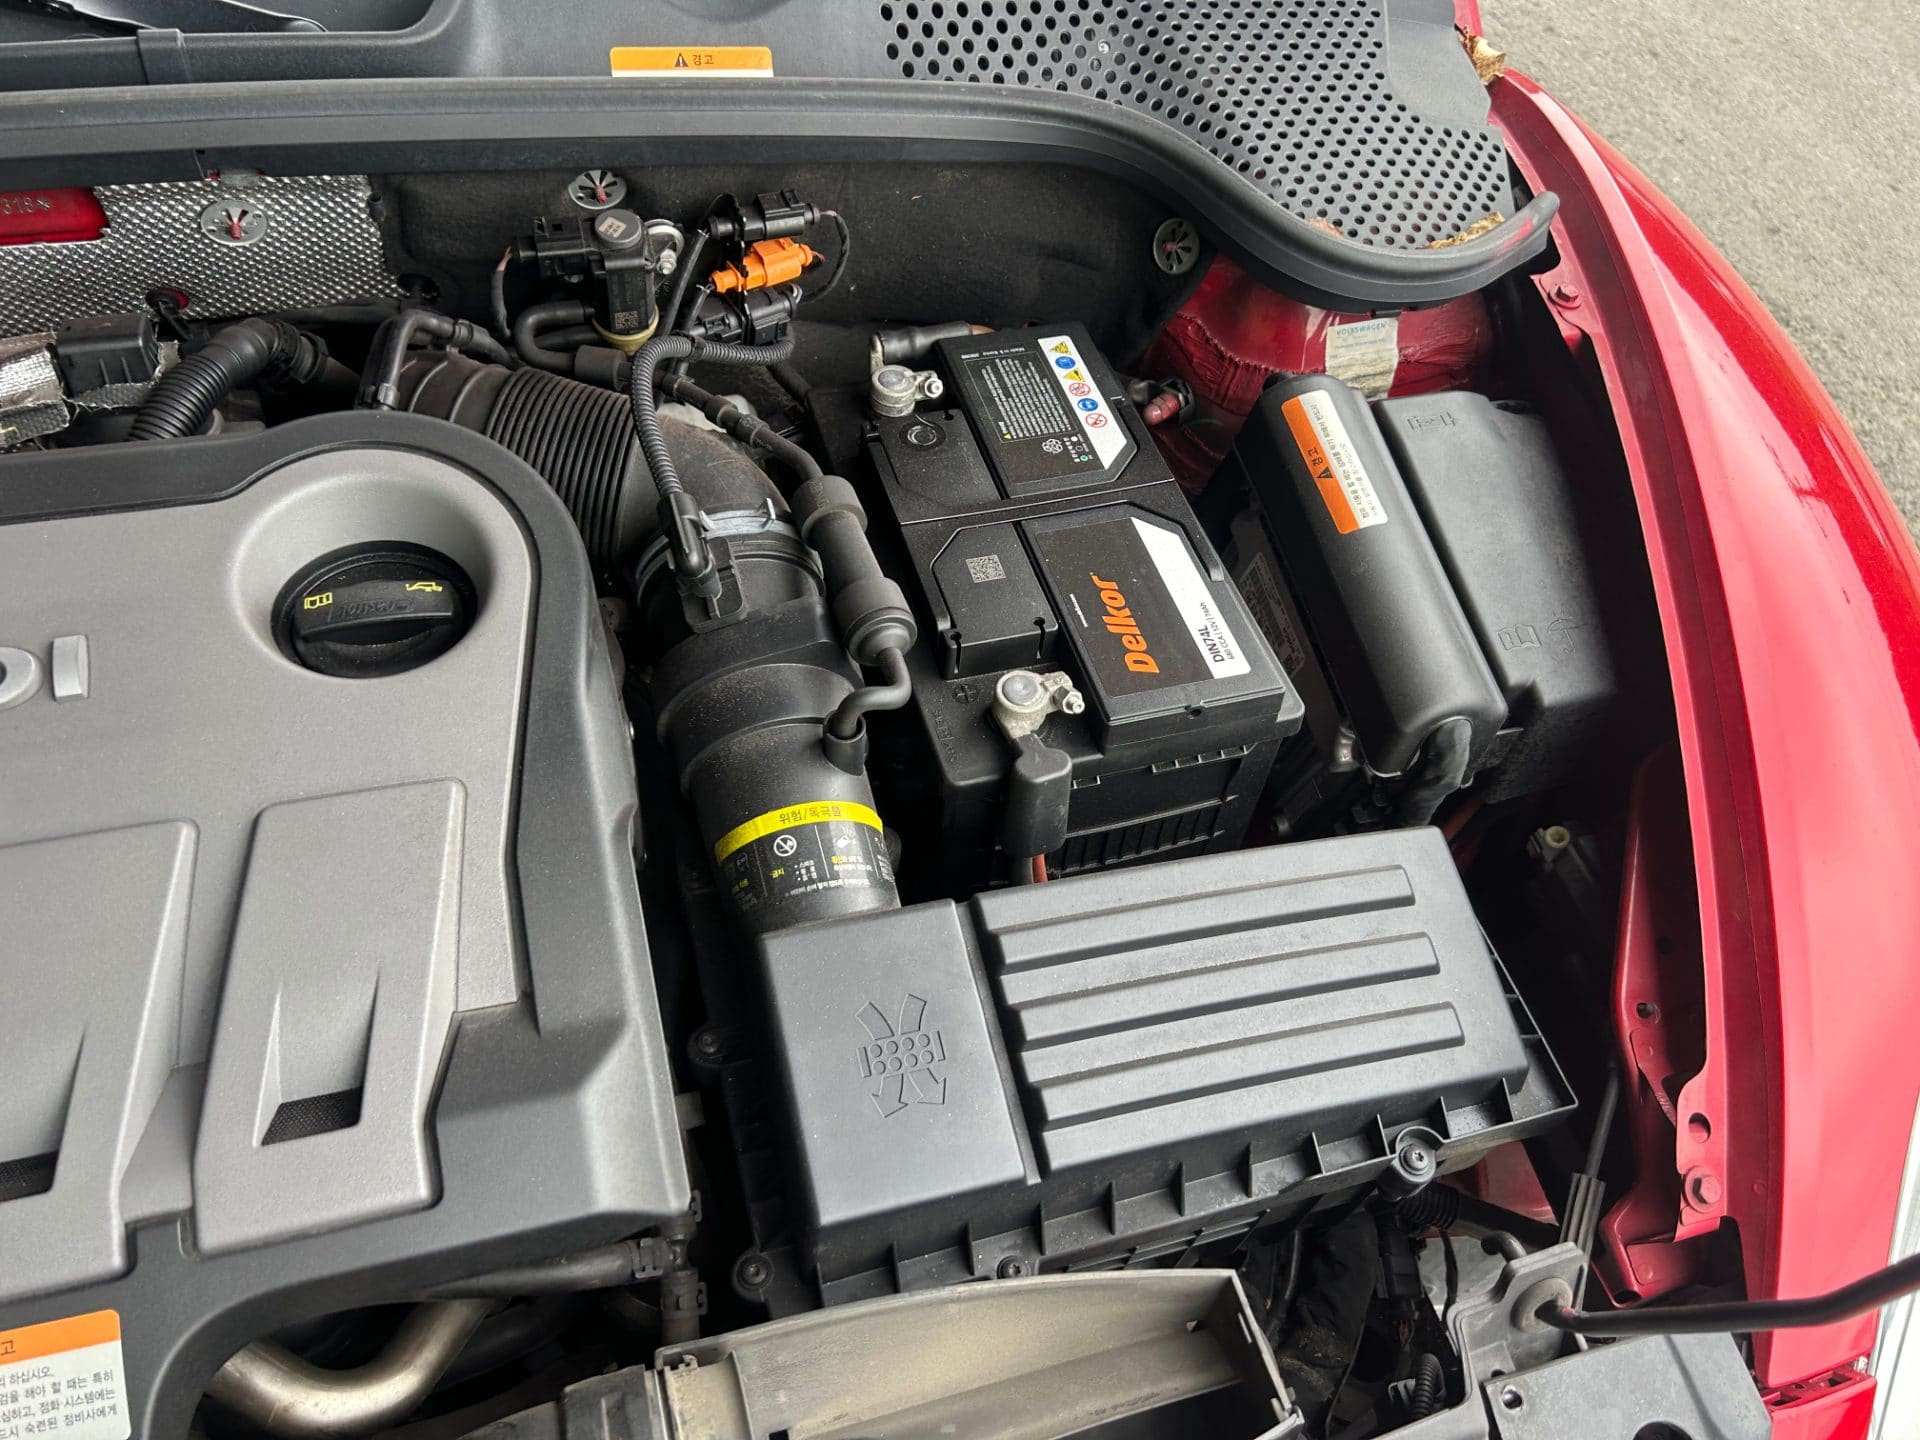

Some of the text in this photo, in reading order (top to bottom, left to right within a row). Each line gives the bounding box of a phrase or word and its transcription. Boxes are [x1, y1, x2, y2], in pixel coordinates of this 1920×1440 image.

[692, 54, 714, 66] 경고
[1336, 322, 1387, 337] VOLKSWAGEN
[1308, 447, 1323, 467] 경고
[1092, 574, 1160, 673] Delkor
[1198, 625, 1225, 662] DIN74L
[0, 1406, 36, 1423] 심하고,
[64, 1388, 115, 1407] 시스템에는
[64, 1402, 117, 1426] 정비사에게
